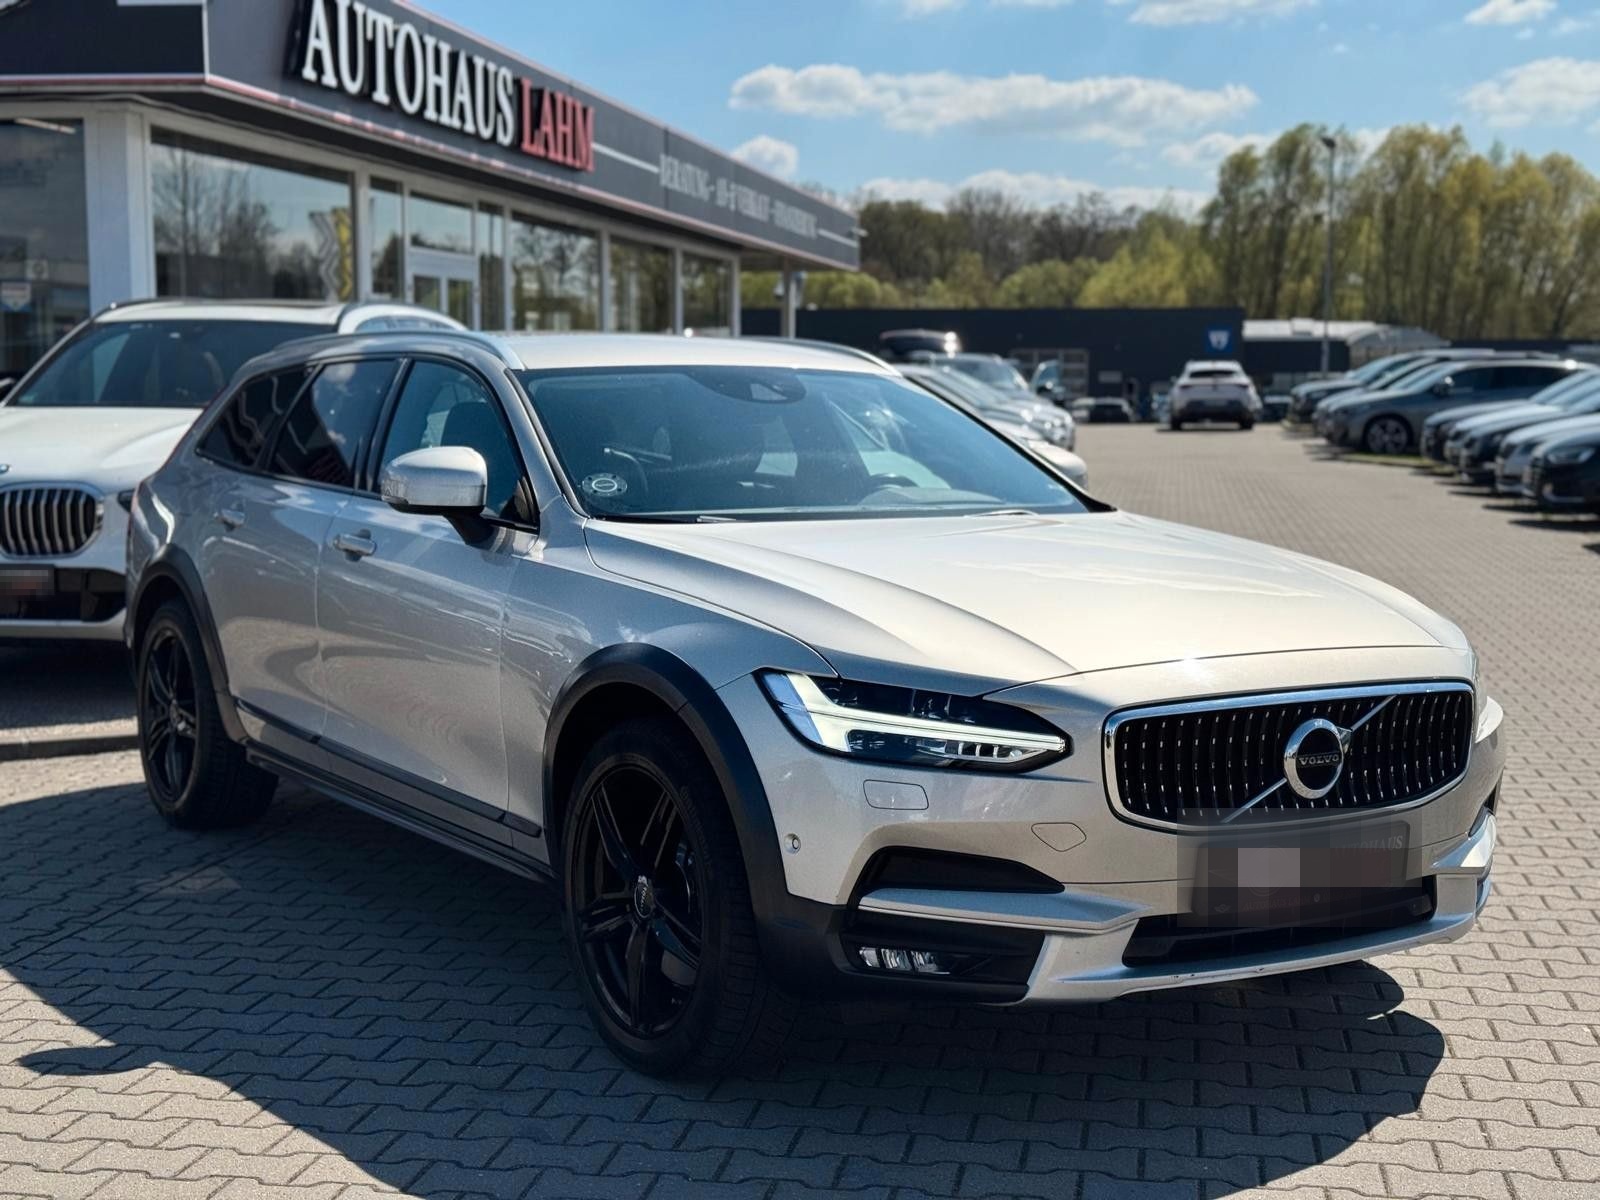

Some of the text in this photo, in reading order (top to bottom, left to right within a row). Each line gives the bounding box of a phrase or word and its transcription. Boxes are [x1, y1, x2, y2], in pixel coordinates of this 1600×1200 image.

[302, 0, 595, 172] AUTOHAUS LAHM
[1299, 753, 1339, 765] VOLVO
